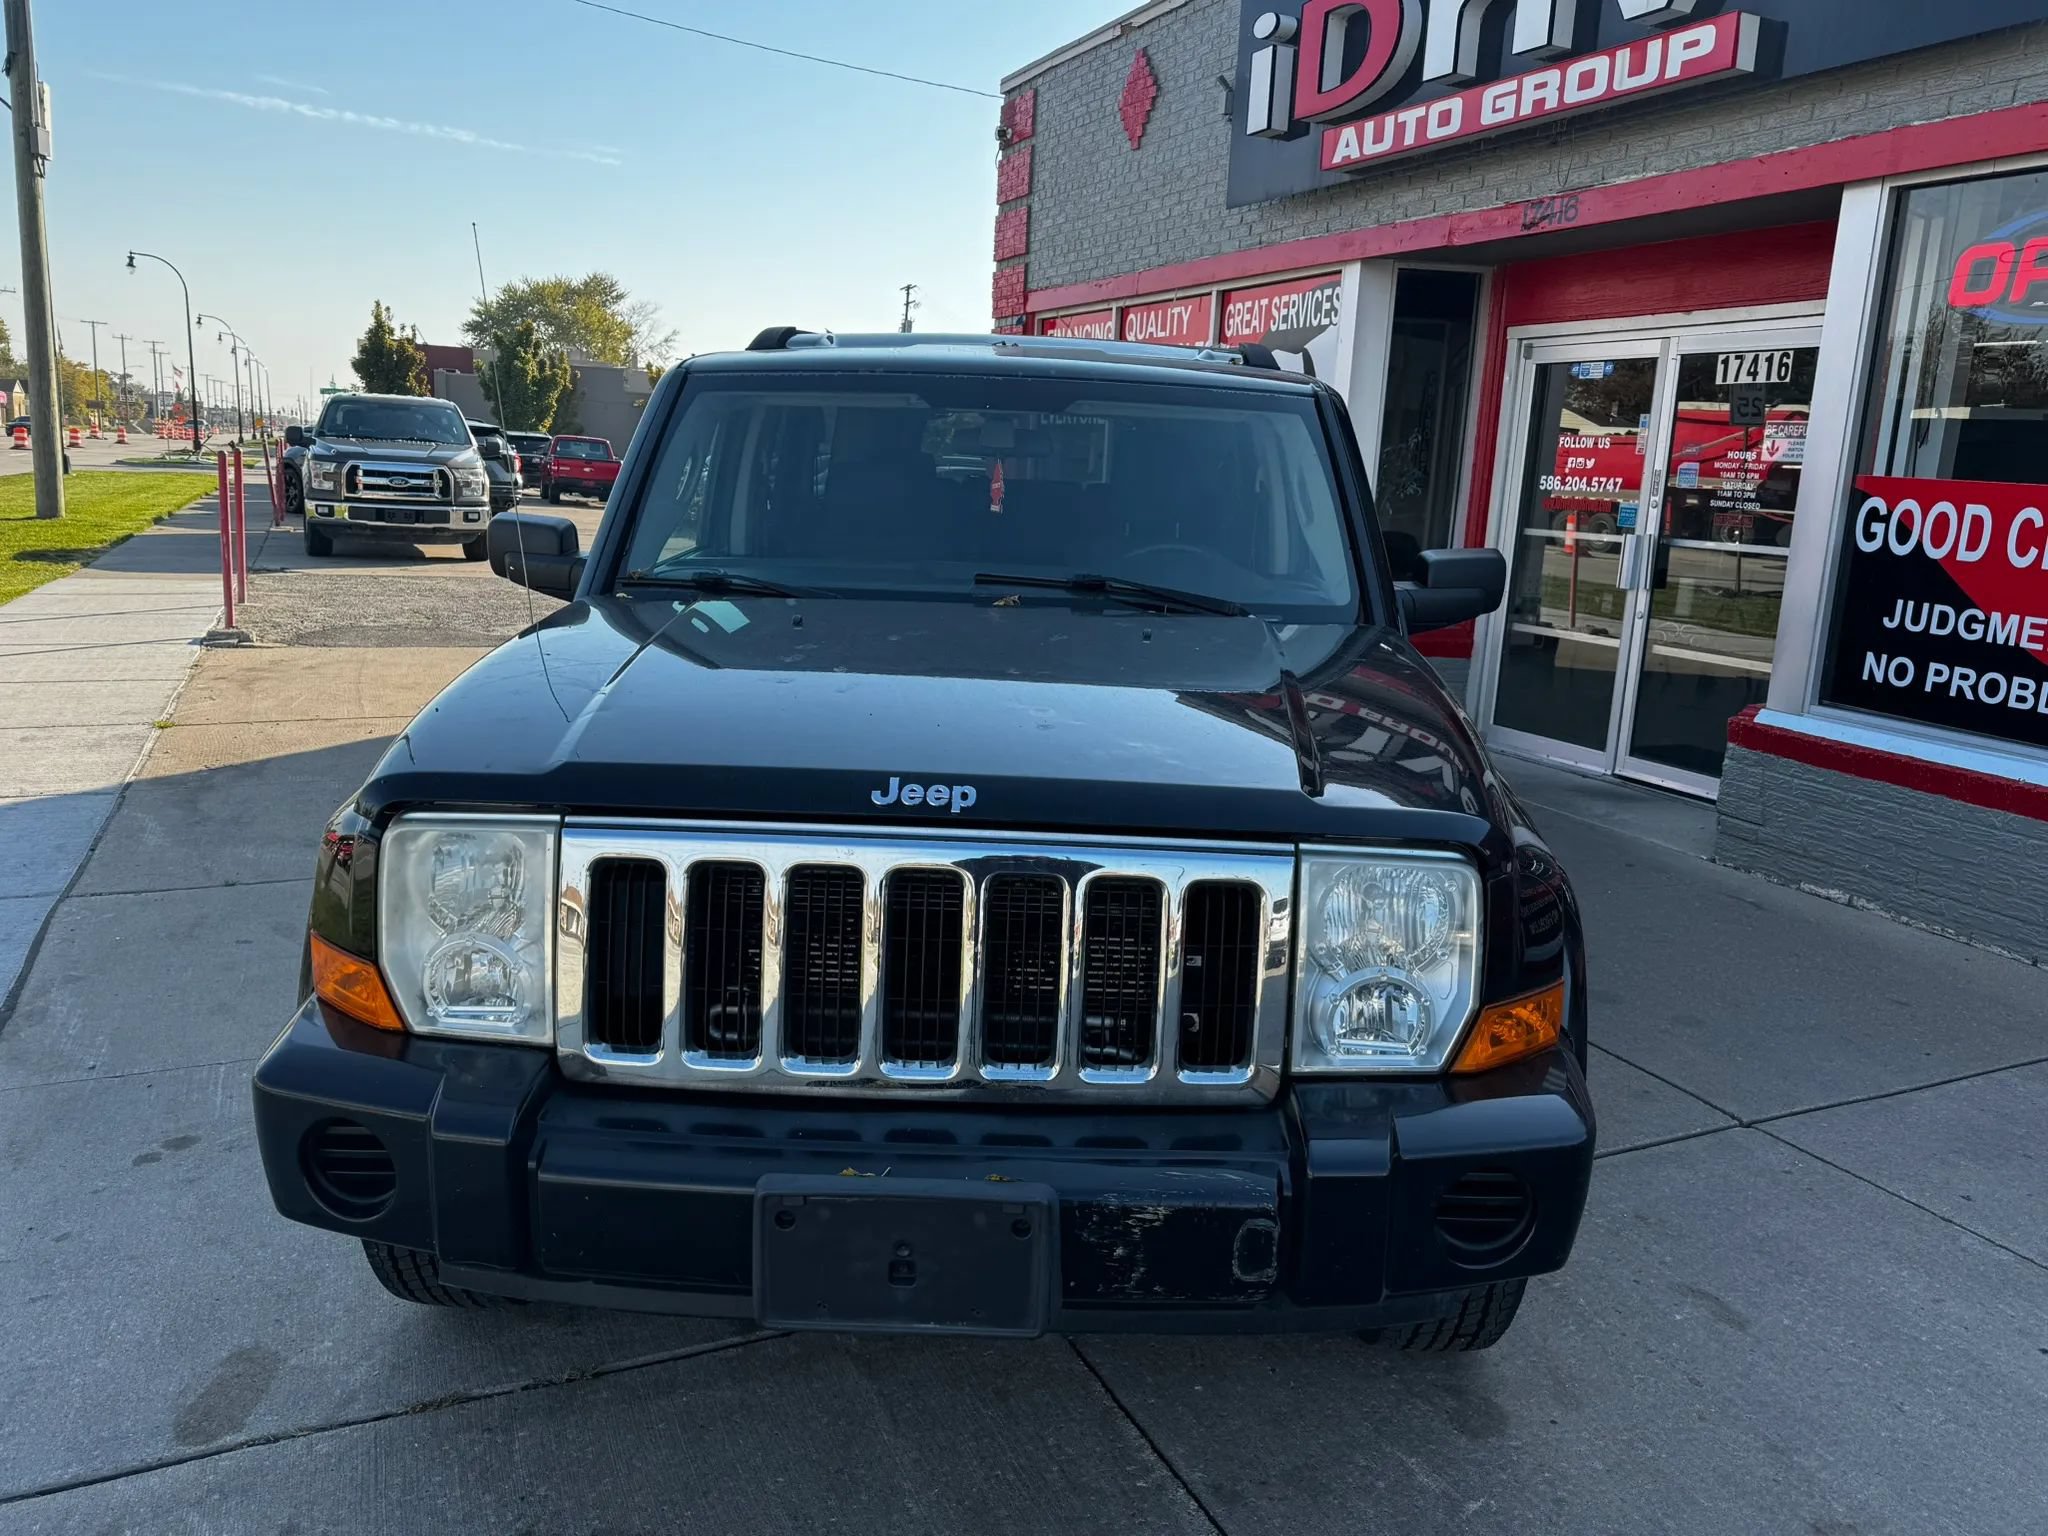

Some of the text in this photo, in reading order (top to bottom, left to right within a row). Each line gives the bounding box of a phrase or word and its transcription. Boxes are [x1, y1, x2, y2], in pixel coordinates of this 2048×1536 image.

[1331, 24, 1717, 164] AUTO GROUP
[1125, 305, 1193, 341] QUALITY
[1224, 286, 1342, 337] GREAT SERVICES
[1720, 351, 1791, 383] 17416
[1558, 436, 1611, 448] FOLLOW US
[1727, 450, 1757, 460] HOURS
[1714, 461, 1740, 469] MONDAY
[1744, 462, 1767, 470] FRIDAY
[1539, 475, 1623, 493] 586.204.5747
[1710, 499, 1761, 510] SUNDAY CLOSED
[1855, 496, 2048, 571] GOOD C
[1882, 599, 2048, 651] JUDGME
[1862, 651, 1915, 688] NO
[870, 776, 978, 814] Jeep
